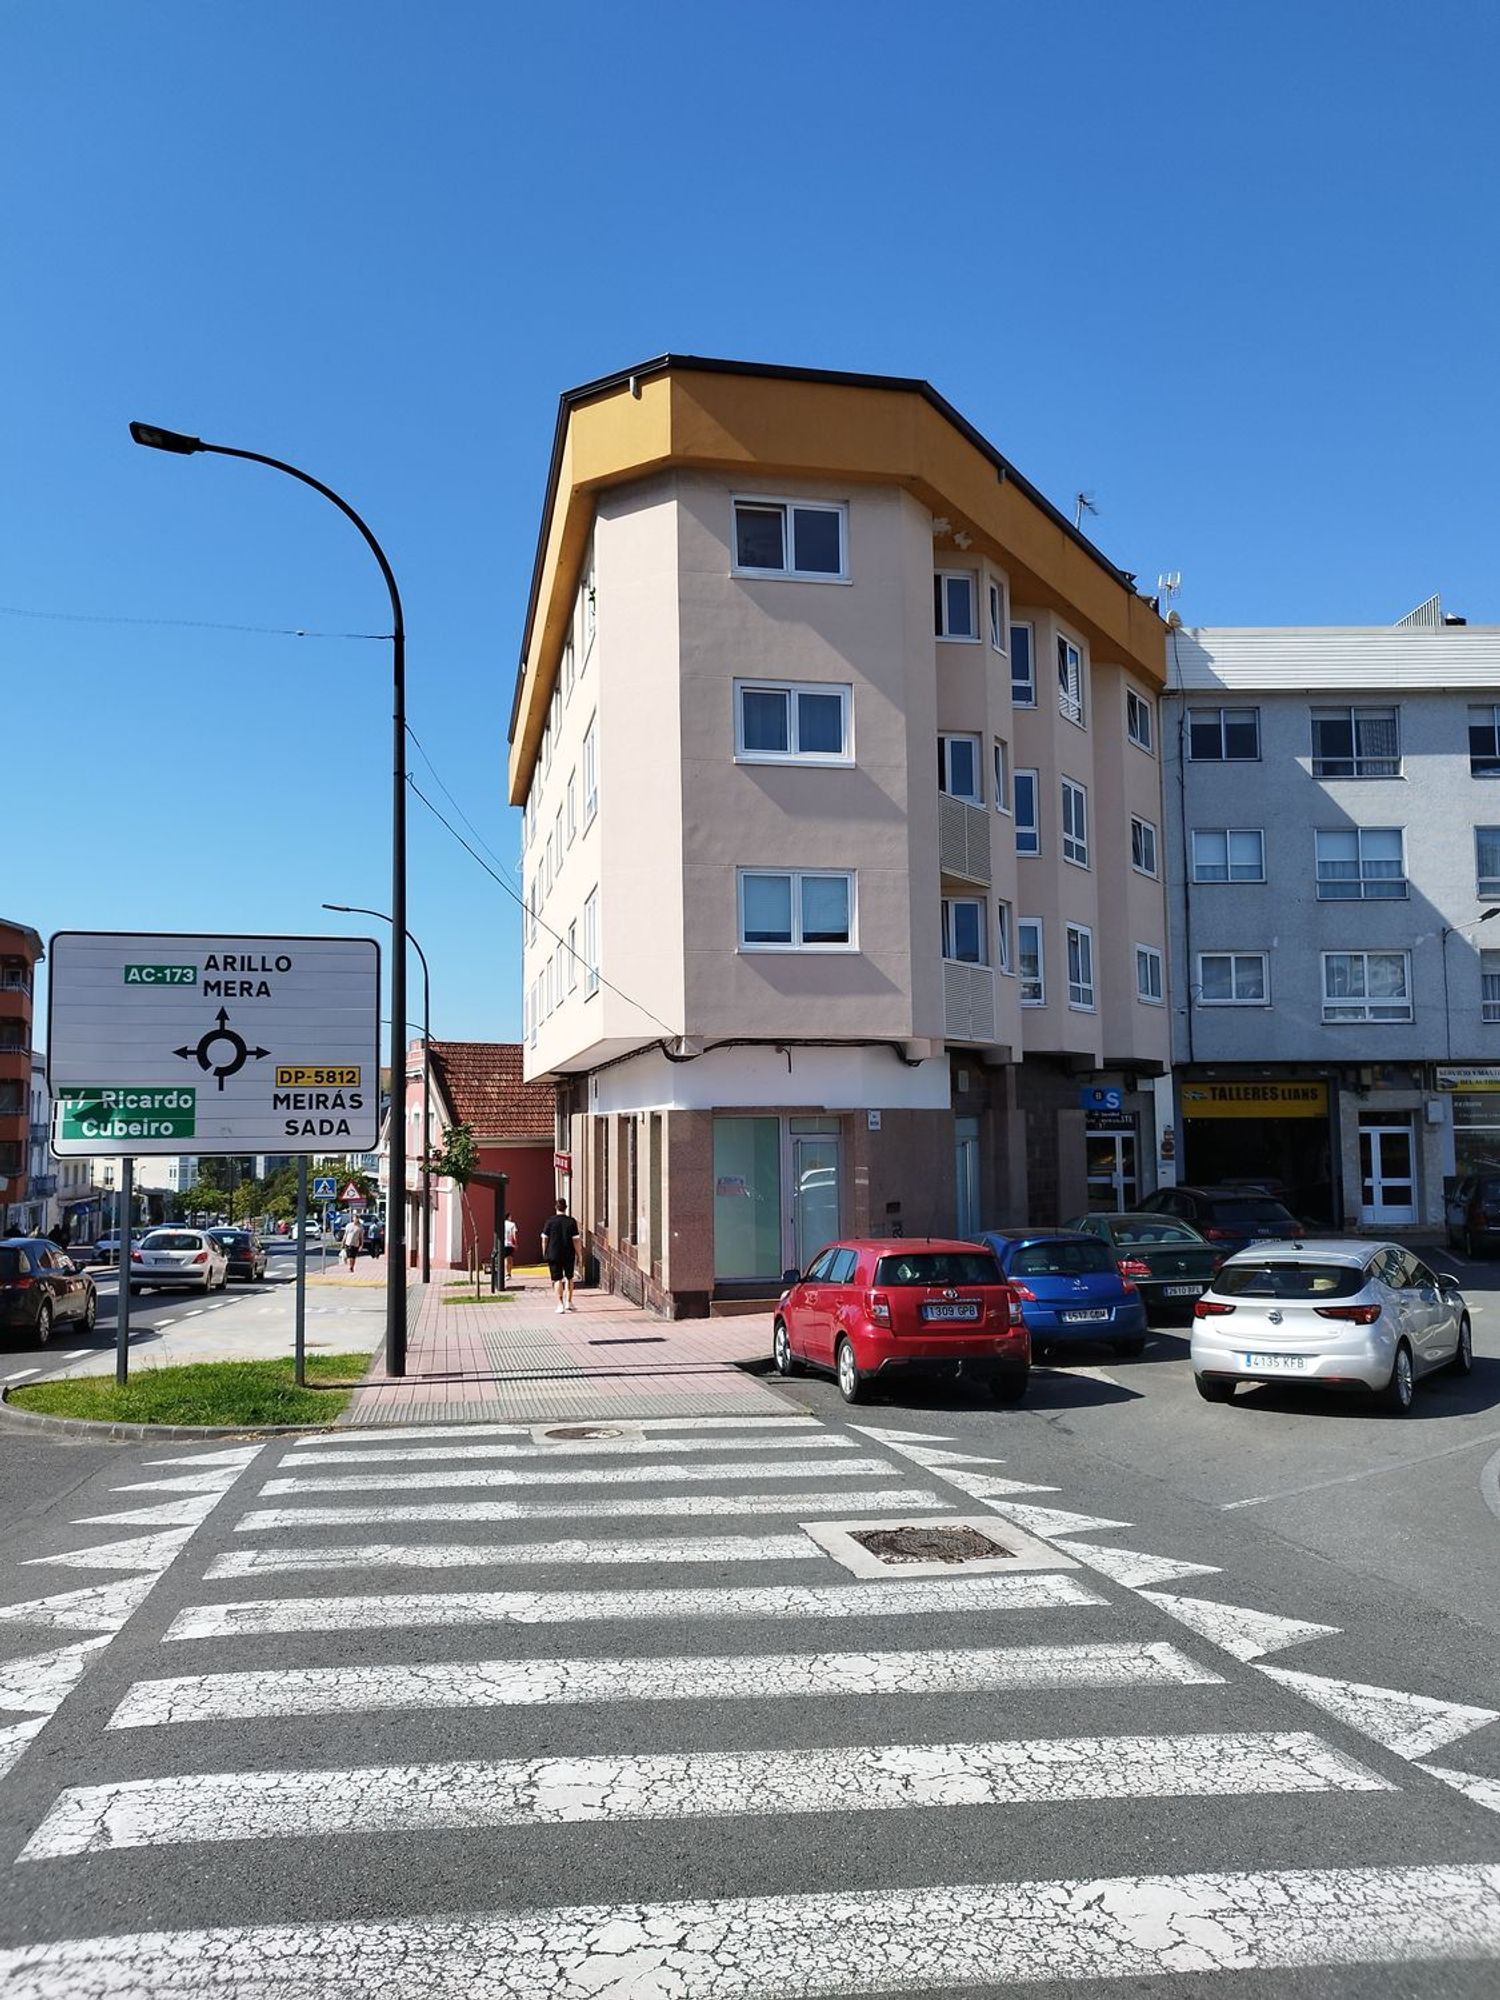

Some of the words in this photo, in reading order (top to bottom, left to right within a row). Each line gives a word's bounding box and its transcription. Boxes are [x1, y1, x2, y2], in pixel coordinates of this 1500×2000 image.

[204, 955, 292, 973] ARILLO
[127, 968, 195, 983] AC-173
[203, 980, 271, 997] MERA
[280, 1070, 357, 1084] DP-5812
[101, 1090, 193, 1109] Ricardo
[273, 1089, 363, 1111] MEIRÁS
[1209, 1086, 1278, 1101] TALLERES
[81, 1117, 174, 1137] Cubeiro
[285, 1119, 350, 1136] SADA
[930, 1306, 954, 1316] 1309
